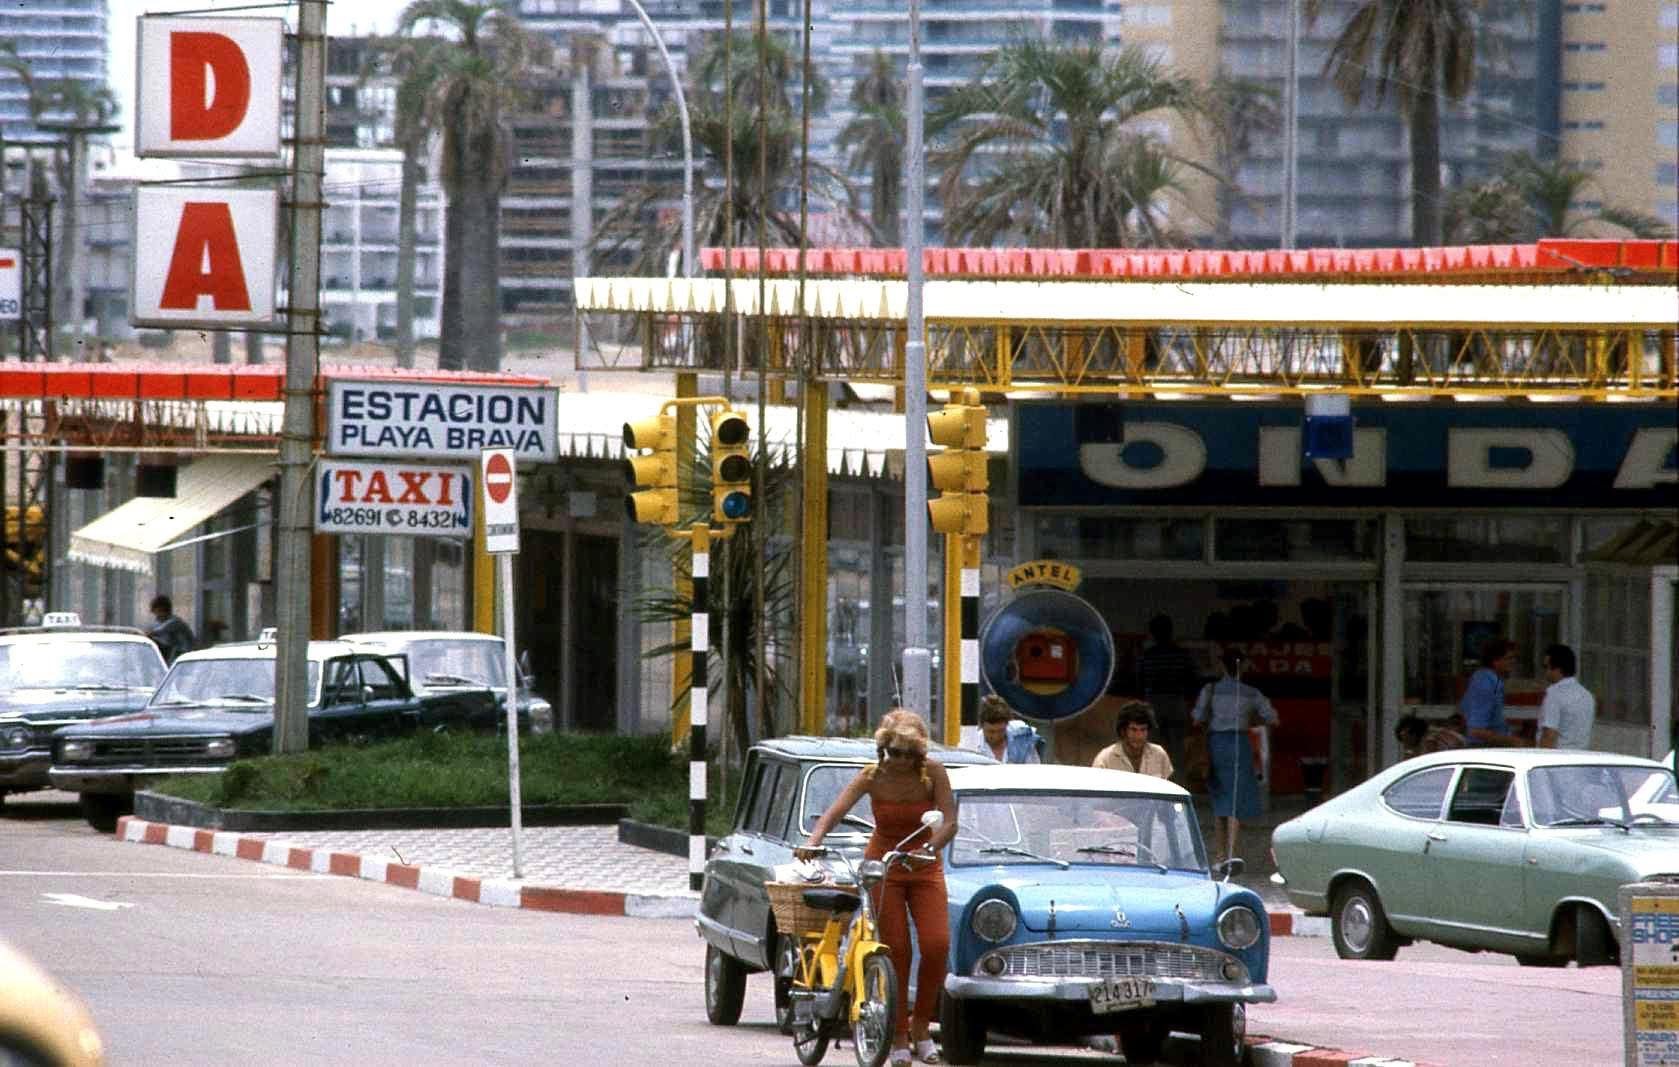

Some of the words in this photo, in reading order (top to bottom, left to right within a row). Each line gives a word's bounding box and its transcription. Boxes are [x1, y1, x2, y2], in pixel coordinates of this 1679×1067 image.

[342, 390, 545, 425] ESTACION
[341, 425, 434, 449] PLAYA
[447, 427, 544, 452] BRAVA
[335, 470, 454, 506] TAXI
[332, 508, 381, 526] 82691
[1013, 564, 1072, 585] ANTEL
